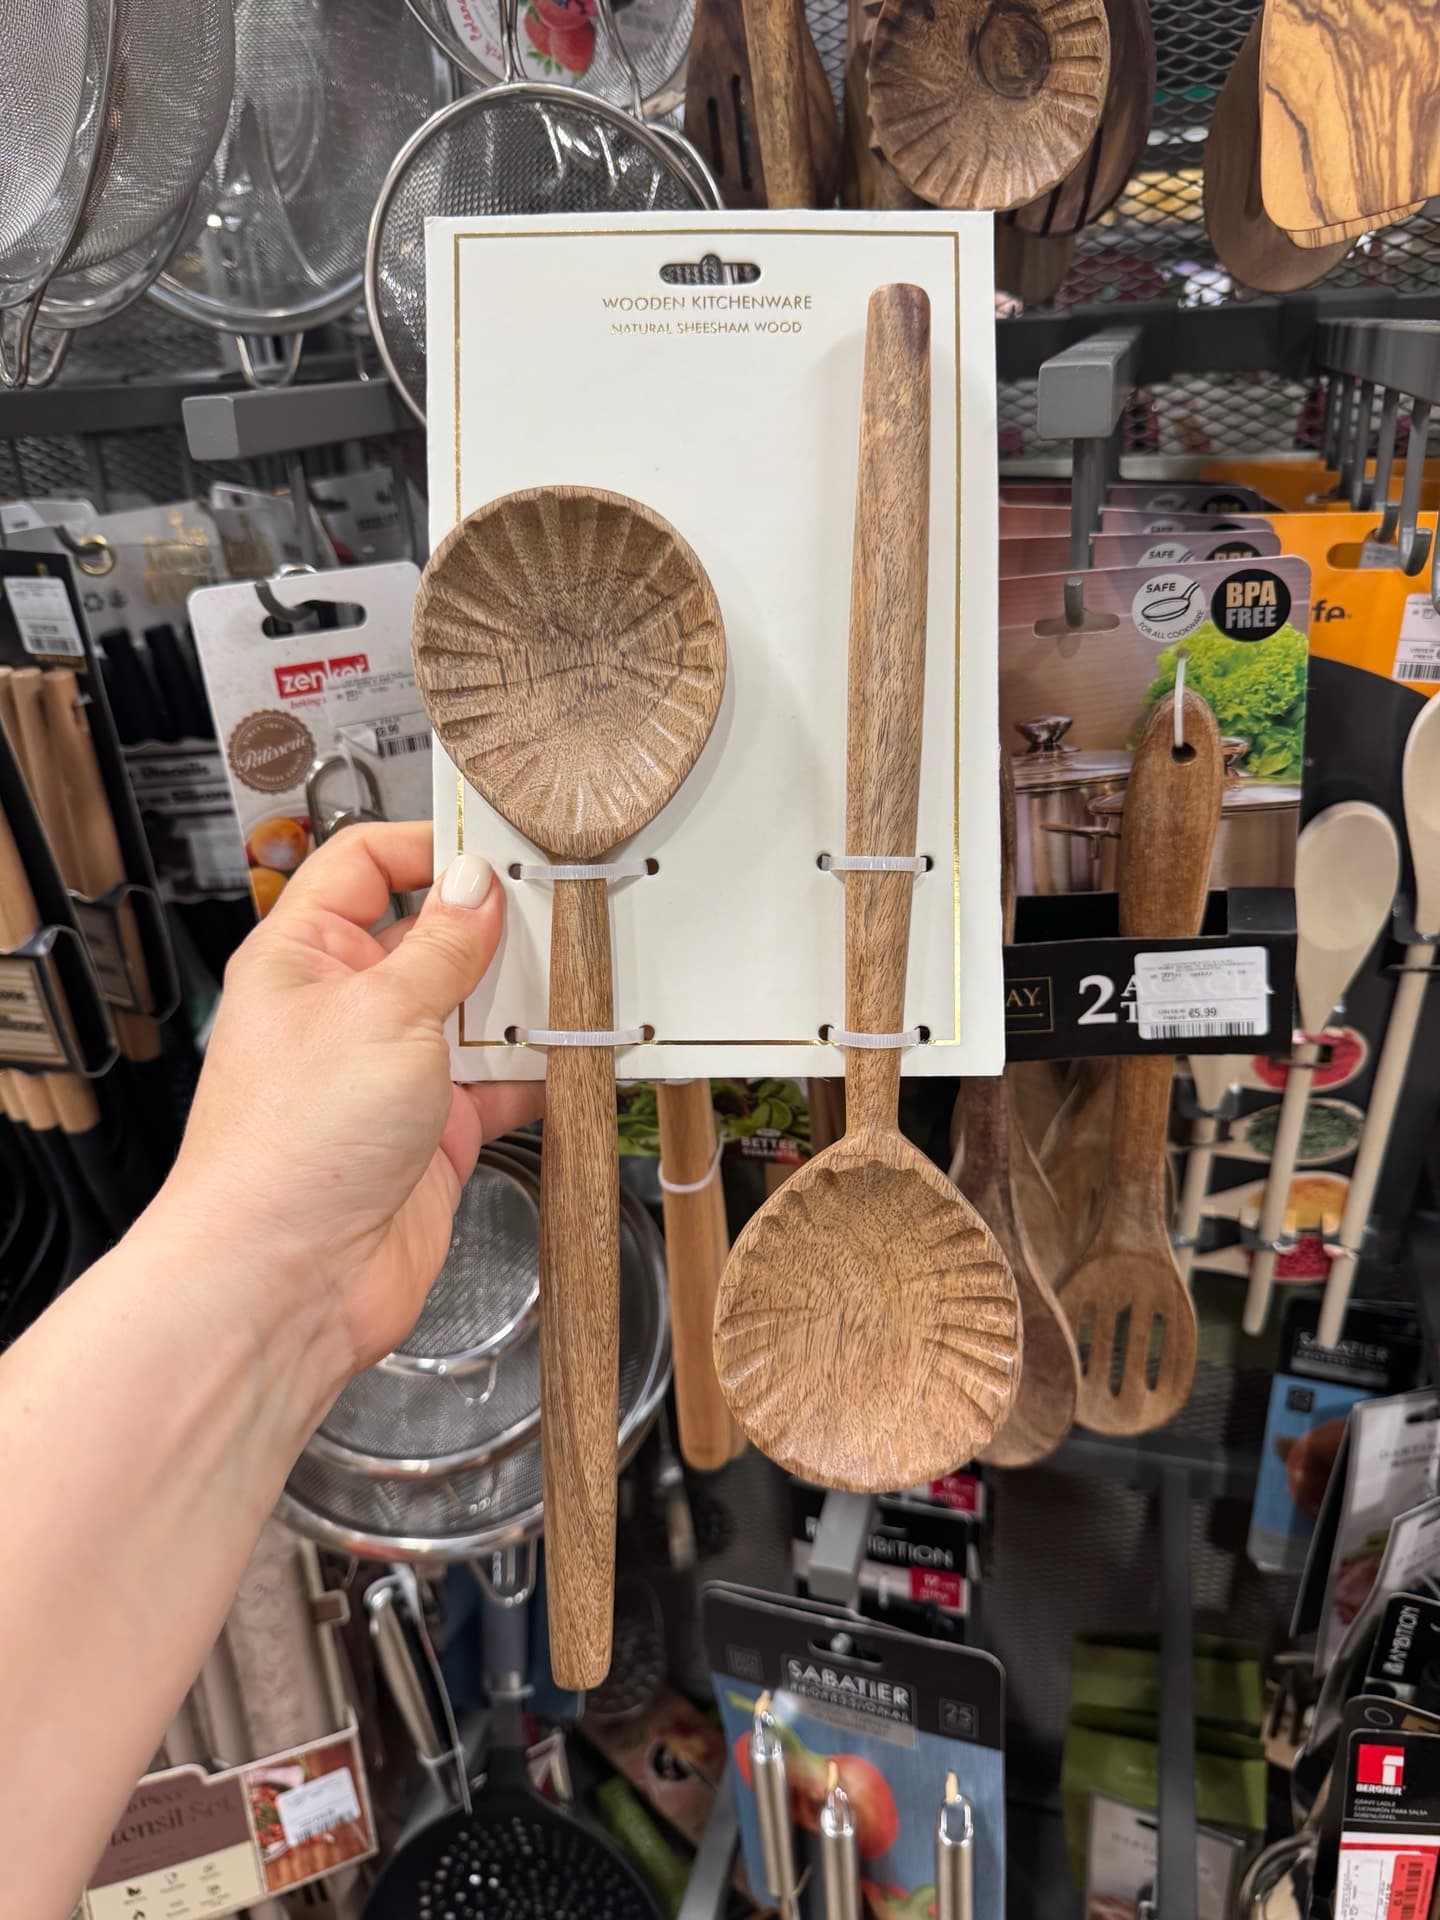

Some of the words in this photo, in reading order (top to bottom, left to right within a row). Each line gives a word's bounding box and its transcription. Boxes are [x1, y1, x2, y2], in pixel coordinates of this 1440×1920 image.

[602, 296, 686, 311] WOODEN
[691, 295, 813, 310] KITCHENWARE
[611, 322, 673, 335] NATURAL
[677, 321, 750, 334] SHEESHAM
[754, 321, 802, 334] WOOD
[1148, 550, 1175, 559] SAFE
[1145, 582, 1177, 594] SAFE
[1225, 580, 1277, 608] BPA
[1138, 621, 1151, 634] FOR
[1152, 630, 1166, 640] ALL
[1166, 610, 1205, 640] COOKWARE
[1225, 606, 1277, 630] FREE
[279, 661, 367, 695] zenker
[1077, 974, 1118, 1025] 2
[1188, 1007, 1217, 1018] €5.99
[787, 1658, 911, 1707] SABATIER
[1355, 1783, 1403, 1796] BERGNER
